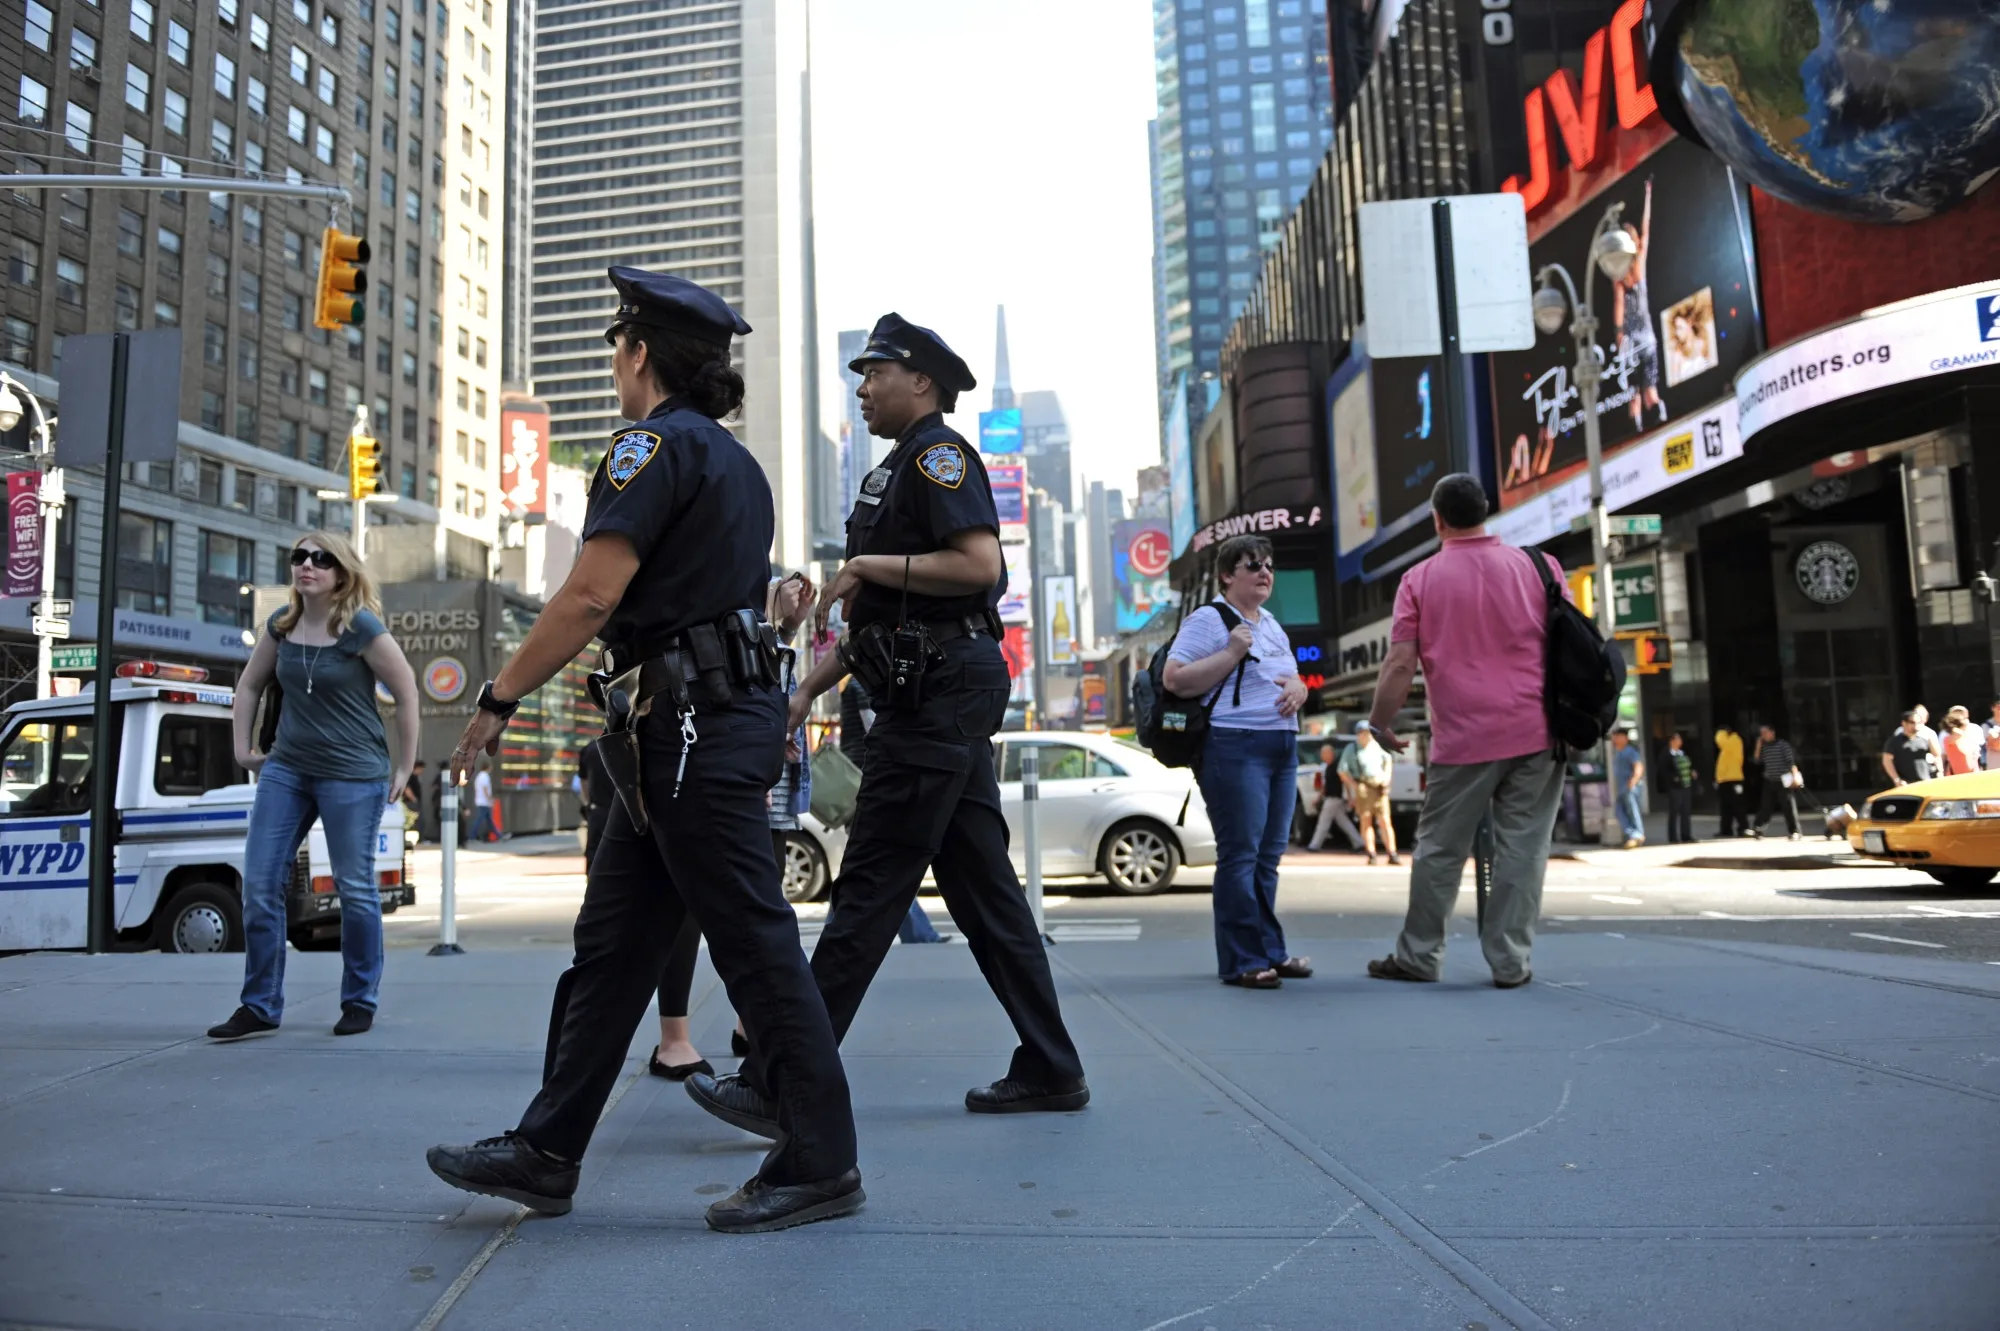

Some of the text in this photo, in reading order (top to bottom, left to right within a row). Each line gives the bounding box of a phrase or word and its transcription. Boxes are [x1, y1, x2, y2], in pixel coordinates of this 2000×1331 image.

[1501, 0, 1658, 212] JVC
[1930, 349, 1998, 371] GRAMMY
[614, 440, 655, 451] DEPARTMENT
[927, 446, 949, 457] POLICE
[1667, 440, 1692, 457] BEST
[922, 450, 959, 467] DEPARTMENT
[1668, 454, 1690, 469] BUY
[14, 514, 39, 529] FREE
[1215, 508, 1291, 541] SAWYER
[15, 528, 37, 543] WIFI
[1130, 532, 1171, 576] LG
[388, 609, 480, 632] FORCES
[119, 620, 191, 641] PATISSERIE
[396, 633, 469, 653] TATION
[199, 693, 231, 705] POLICE
